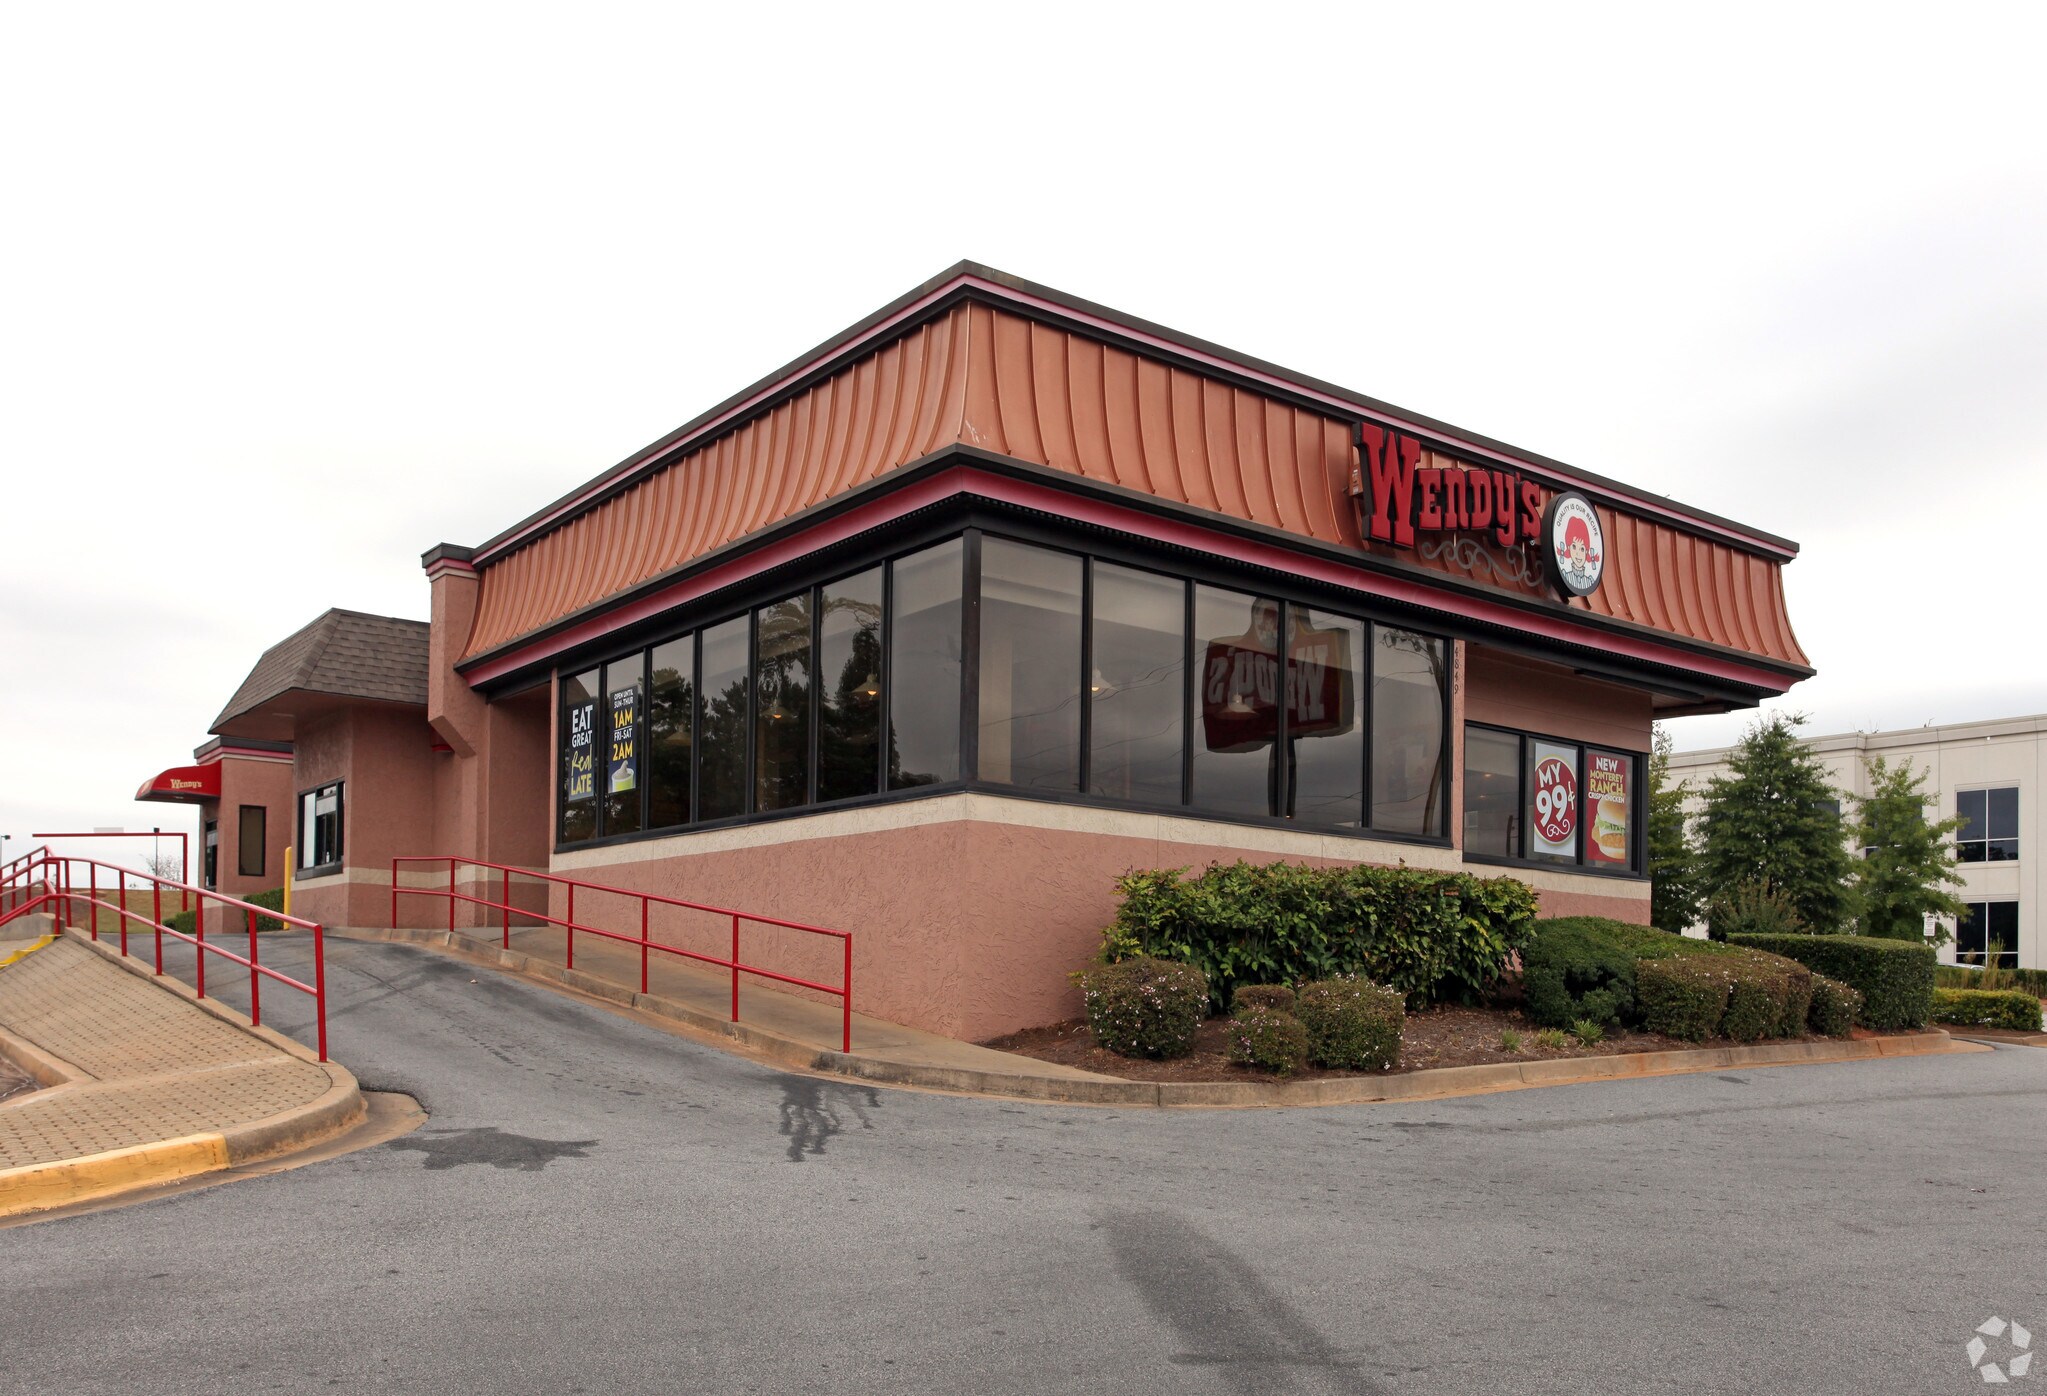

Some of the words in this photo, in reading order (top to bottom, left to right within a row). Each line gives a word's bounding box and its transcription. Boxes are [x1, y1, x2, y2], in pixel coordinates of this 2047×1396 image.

[1556, 504, 1570, 527] QUALITY
[1576, 504, 1586, 515] OUR
[1586, 513, 1599, 536] RECIPE
[614, 692, 623, 700] OPEN
[572, 704, 593, 734] EAT
[613, 706, 633, 729] 1AM
[571, 729, 593, 748] GREAT
[614, 728, 633, 741] FRI-SAT
[571, 743, 593, 777] Real
[612, 739, 633, 761] 2AM
[1596, 756, 1618, 772] NEW
[571, 773, 592, 795] LATE
[1538, 761, 1561, 788] MY
[1590, 769, 1624, 784] MONTEREY
[1589, 778, 1624, 796] RANCH
[1588, 791, 1603, 800] CRISPY
[1602, 793, 1625, 804] CHICKEN
